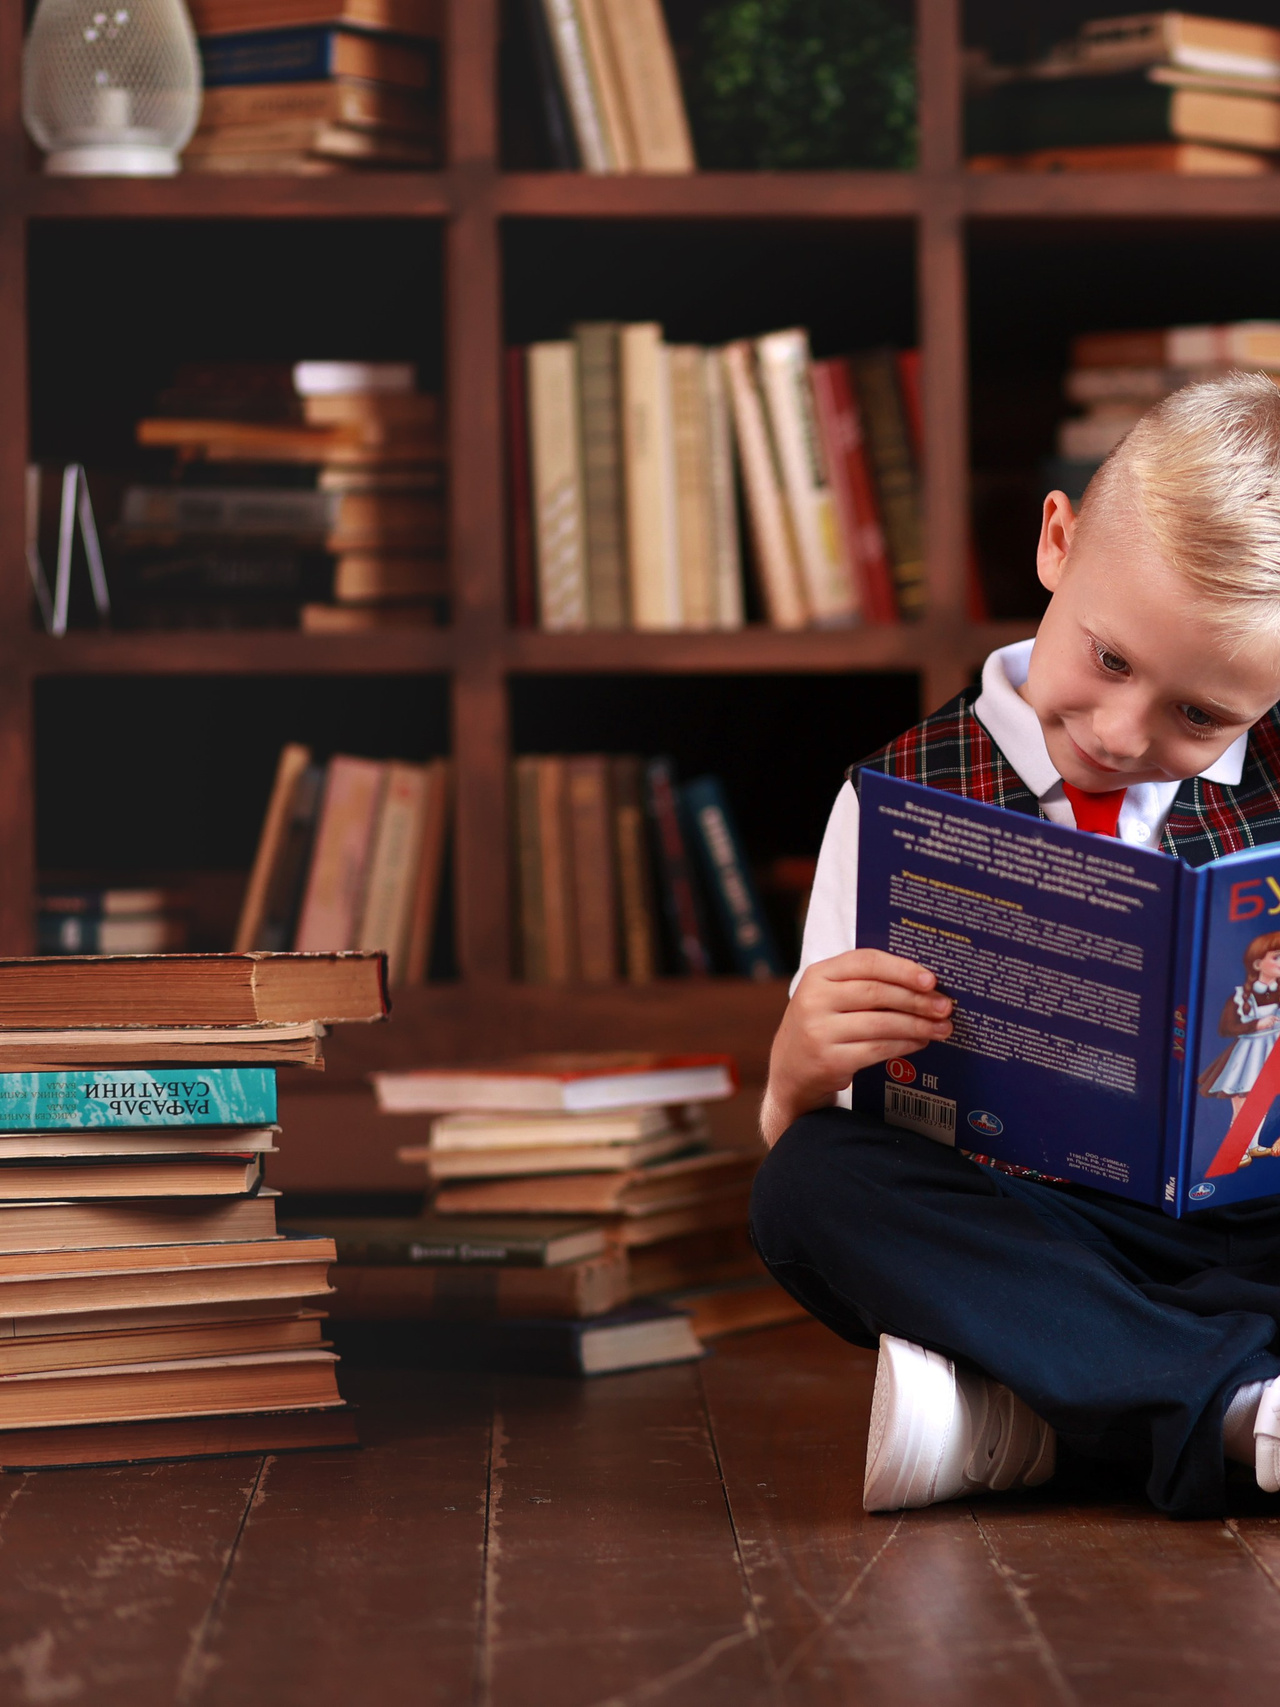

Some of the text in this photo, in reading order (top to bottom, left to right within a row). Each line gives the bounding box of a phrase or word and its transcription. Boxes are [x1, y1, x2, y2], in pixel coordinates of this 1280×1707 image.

[31, 1091, 77, 1099] ХРОНИКА
[84, 1082, 210, 1099] САБАТИНИ
[885, 1084, 902, 1096] ISBN
[110, 1099, 210, 1116] РАФАЭЛЬ
